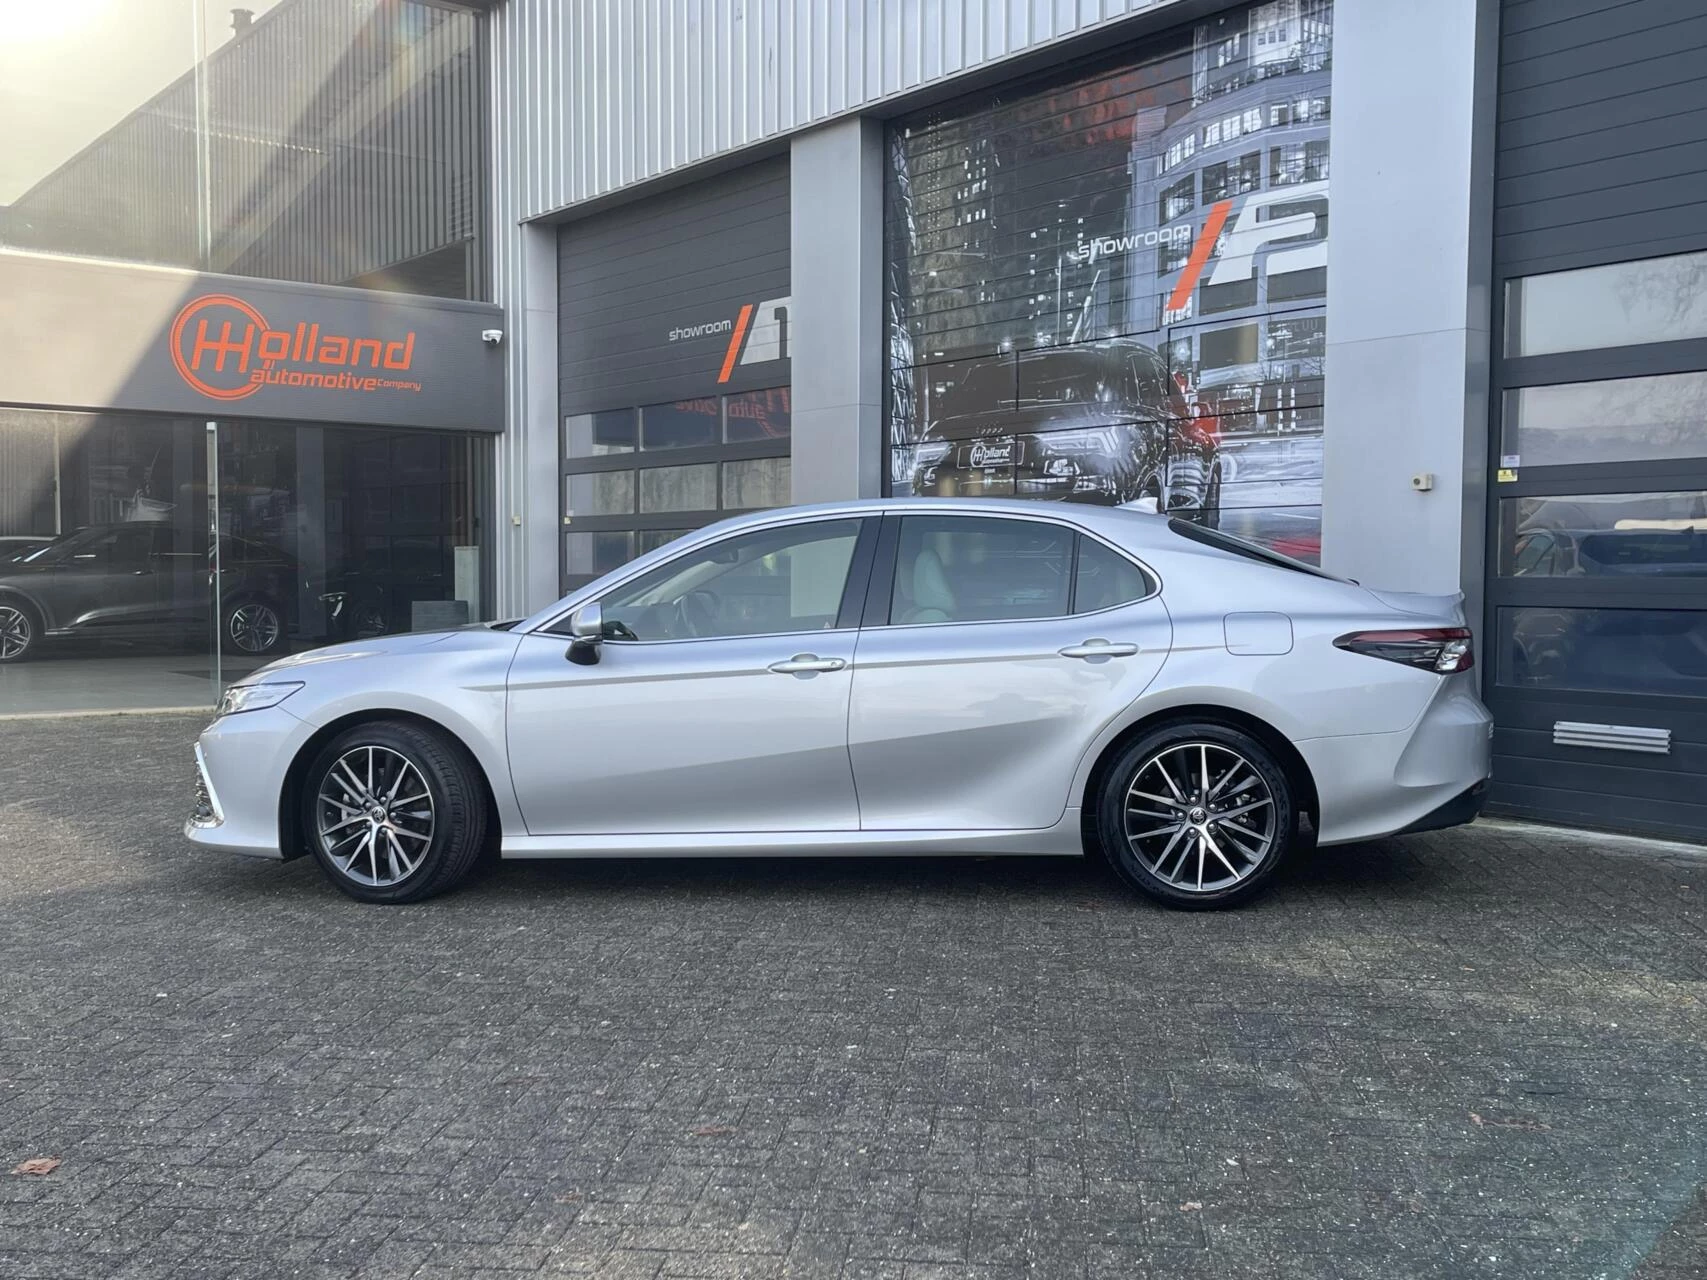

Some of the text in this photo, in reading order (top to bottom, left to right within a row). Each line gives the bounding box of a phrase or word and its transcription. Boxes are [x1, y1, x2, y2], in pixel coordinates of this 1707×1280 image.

[1079, 224, 1192, 260] showroom
[669, 319, 731, 341] showroom
[250, 368, 377, 392] automotive
